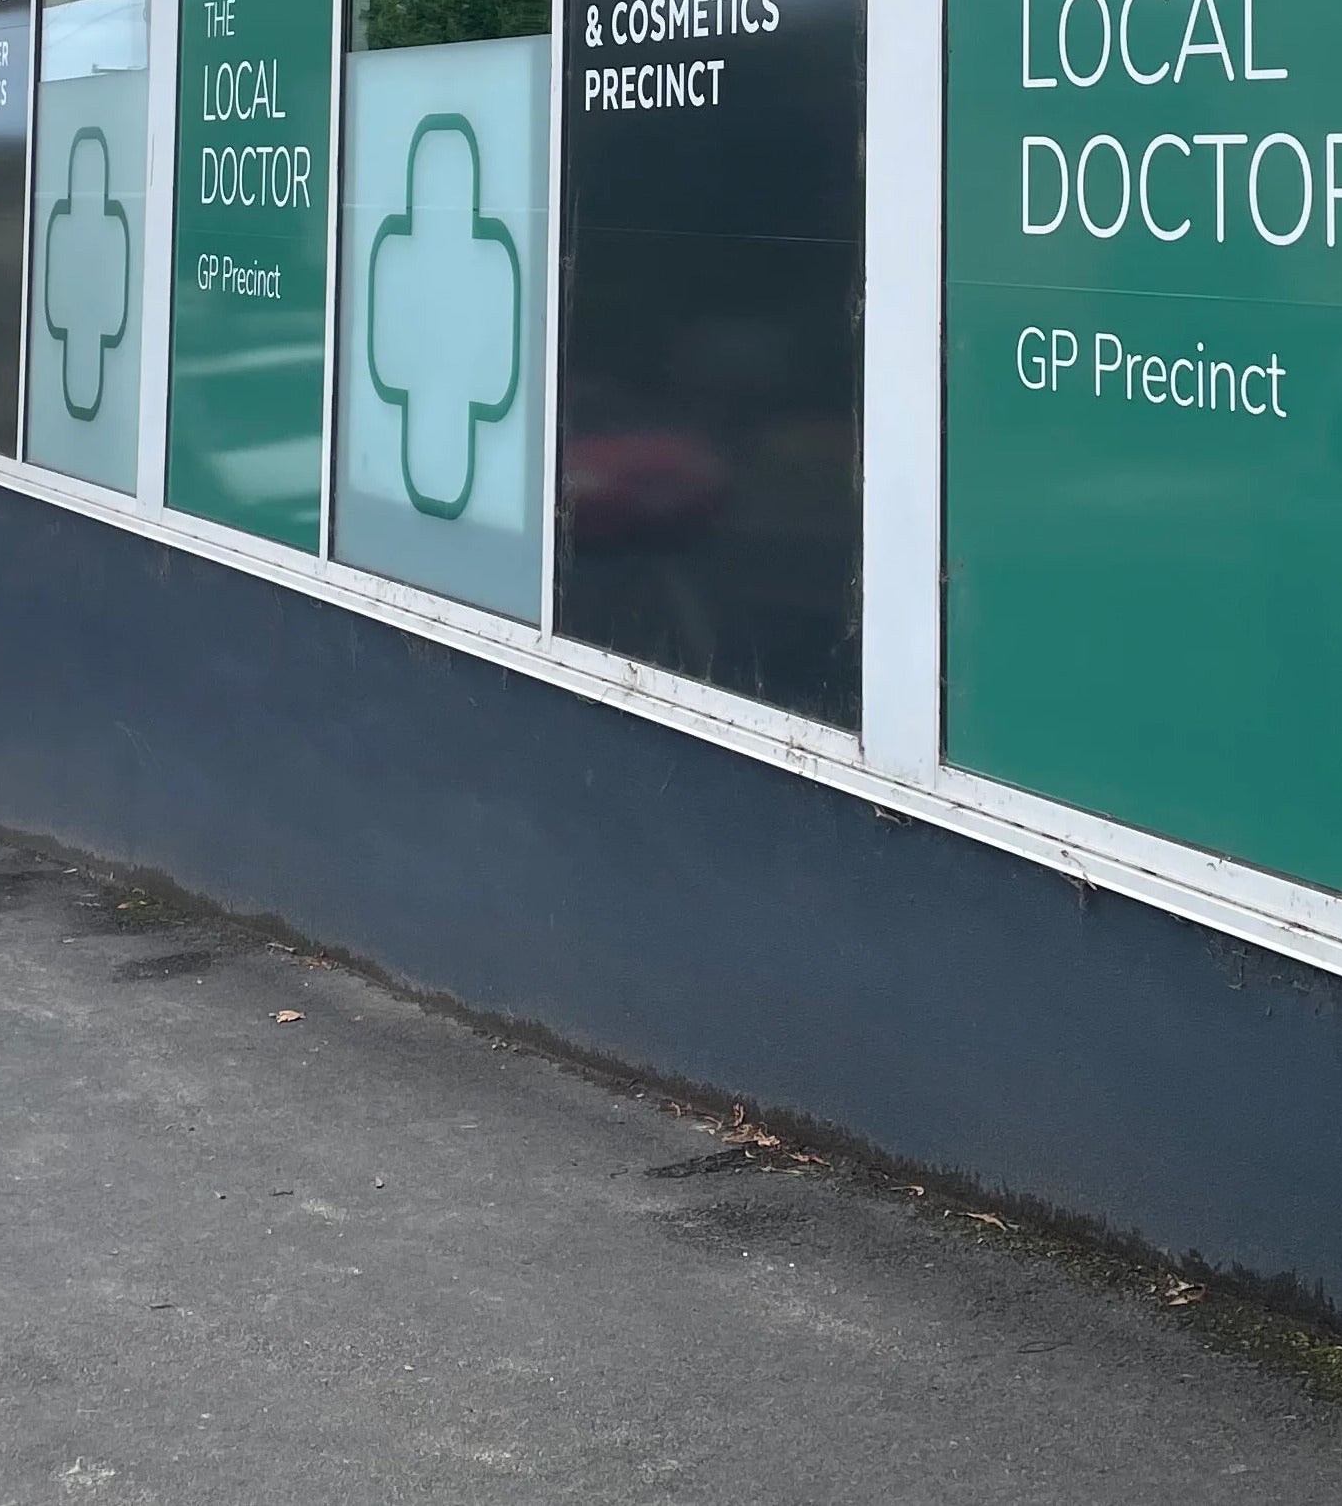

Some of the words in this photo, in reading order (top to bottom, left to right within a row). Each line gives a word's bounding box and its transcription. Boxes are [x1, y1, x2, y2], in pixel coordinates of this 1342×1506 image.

[204, 0, 235, 37] THE
[585, 4, 603, 47] &
[203, 59, 286, 121] LOCAL
[585, 60, 725, 112] PRECINCT
[201, 146, 311, 208] DOCTOR
[198, 254, 218, 290] GP
[223, 256, 281, 299] Precinct
[1017, 326, 1078, 392] GP
[1095, 332, 1288, 419] Precinct
